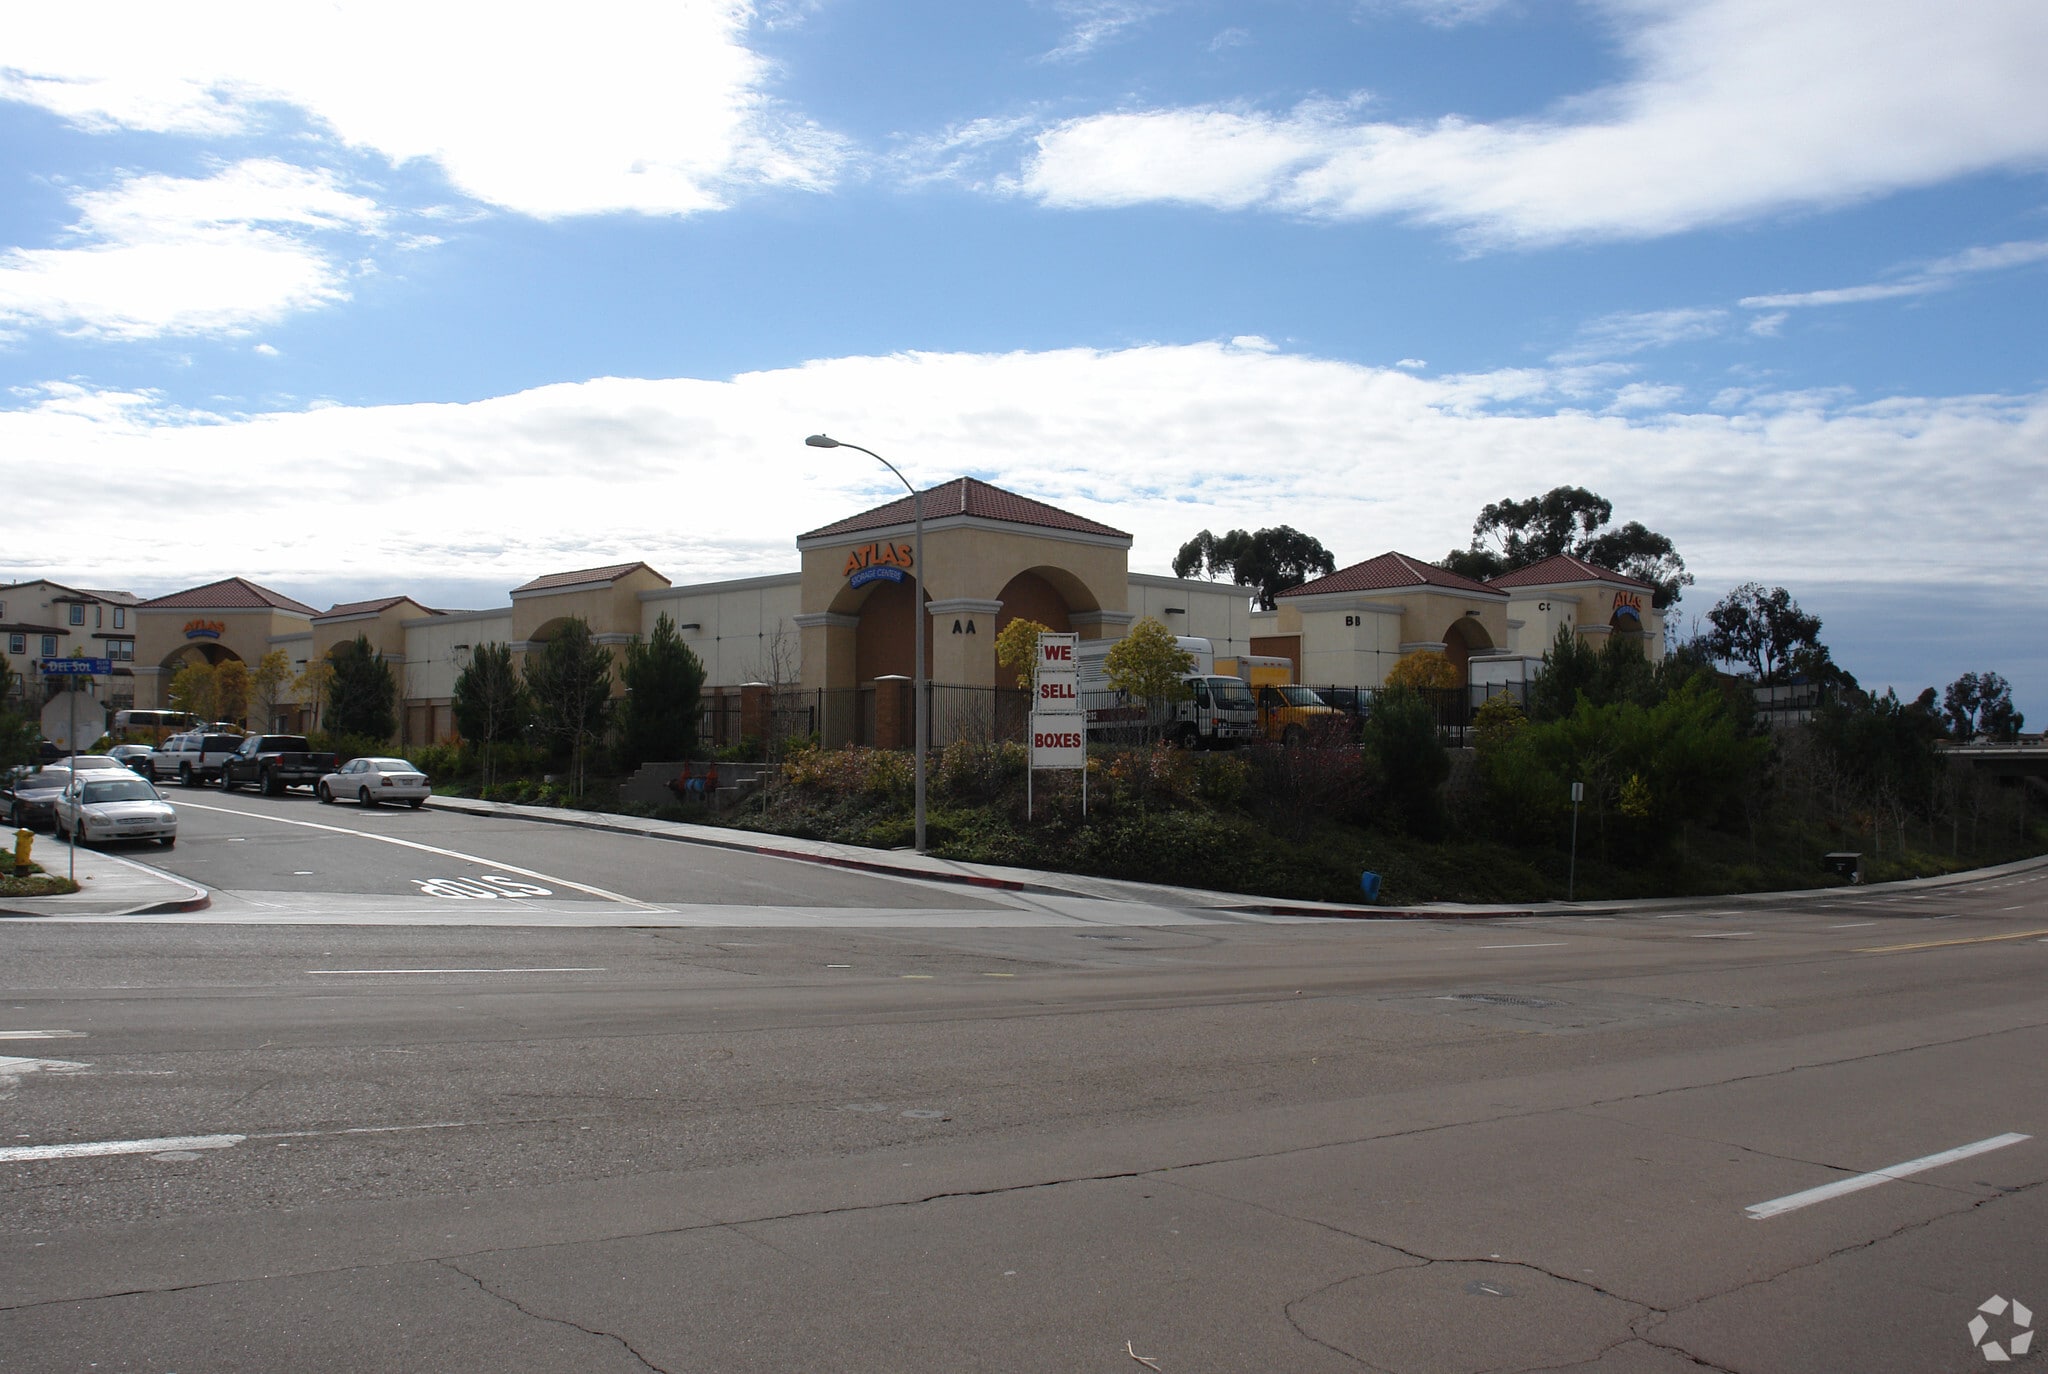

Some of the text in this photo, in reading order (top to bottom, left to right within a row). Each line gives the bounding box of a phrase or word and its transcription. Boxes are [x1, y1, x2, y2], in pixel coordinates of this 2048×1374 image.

[843, 543, 914, 576] ATLAS
[851, 568, 876, 586] STORAGE
[183, 619, 225, 633] ATLAS
[1044, 645, 1072, 661] WE
[1041, 684, 1076, 699] SELL
[1035, 733, 1081, 748] BOXES
[410, 875, 553, 900] STOP
